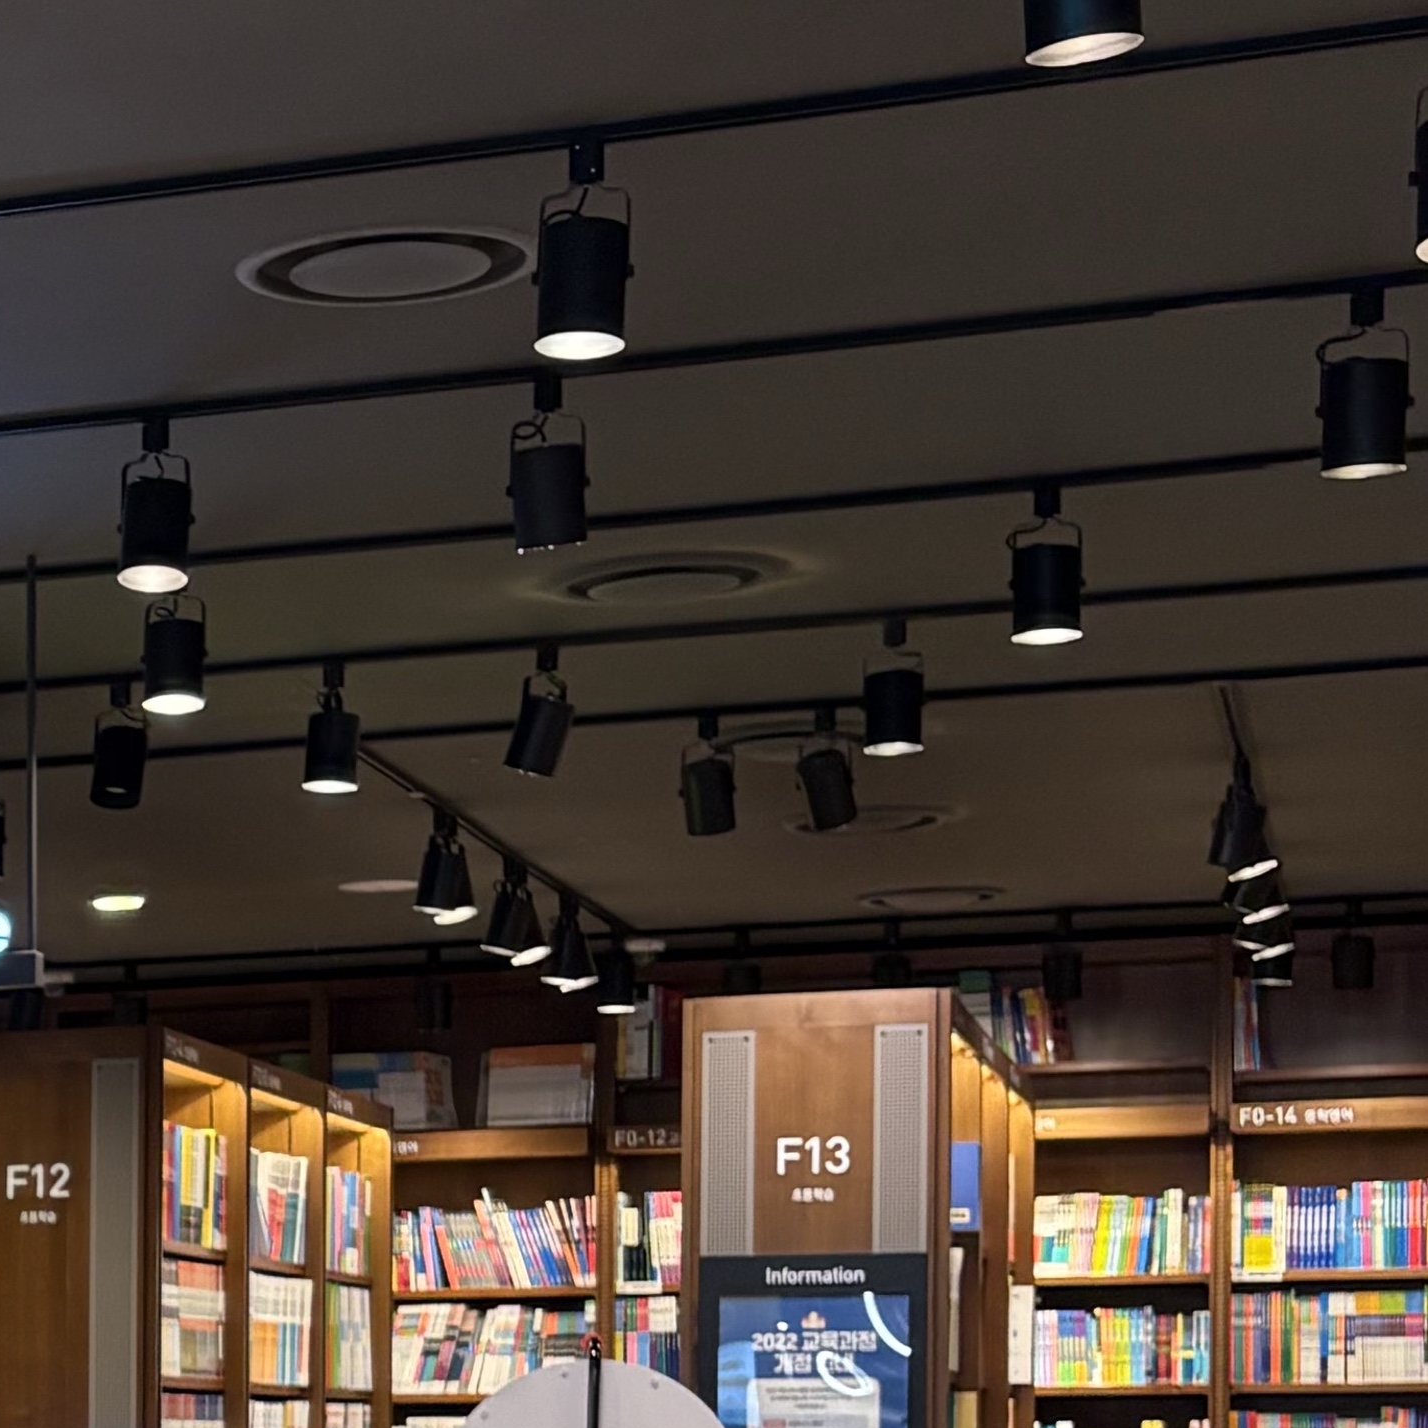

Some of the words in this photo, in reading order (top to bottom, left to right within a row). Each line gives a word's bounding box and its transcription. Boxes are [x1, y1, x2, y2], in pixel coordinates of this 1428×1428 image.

[776, 1135, 851, 1176] F13
[5, 1162, 71, 1200] F12
[764, 1265, 867, 1288] Information
[751, 1333, 799, 1352] 2022
